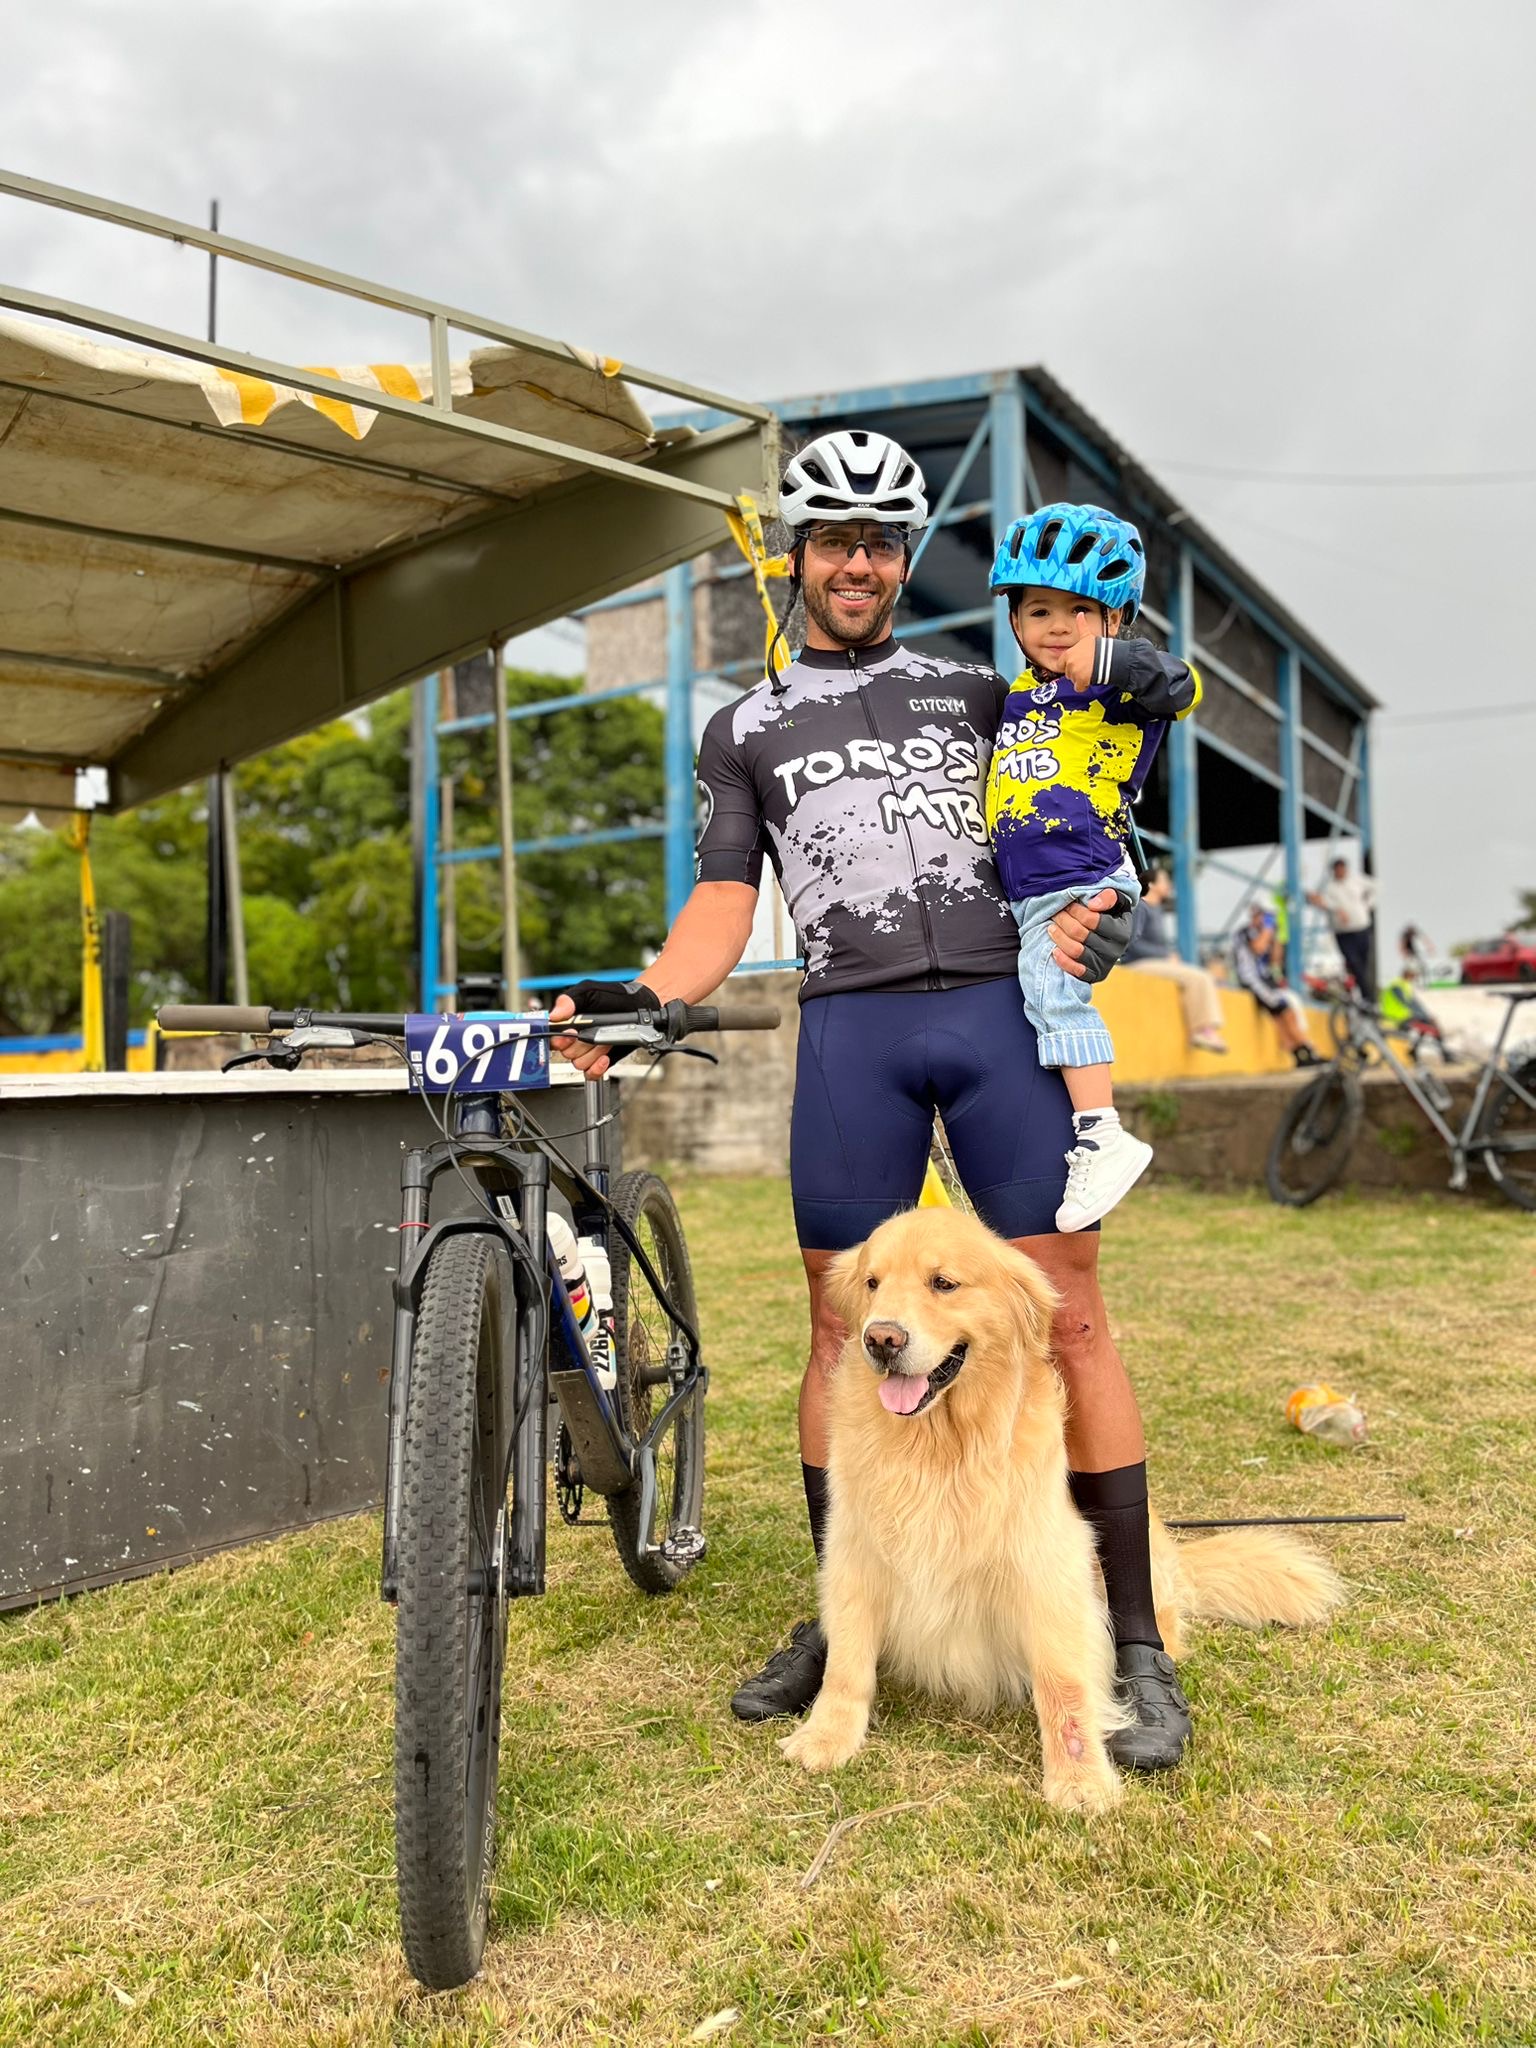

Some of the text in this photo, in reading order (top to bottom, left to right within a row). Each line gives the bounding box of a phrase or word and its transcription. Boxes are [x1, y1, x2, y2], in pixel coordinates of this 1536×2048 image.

[995, 718, 1061, 749] ROS
[773, 737, 979, 808] TOROS
[998, 748, 1060, 783] MTB
[881, 783, 990, 846] MTB
[425, 1023, 531, 1085] 697
